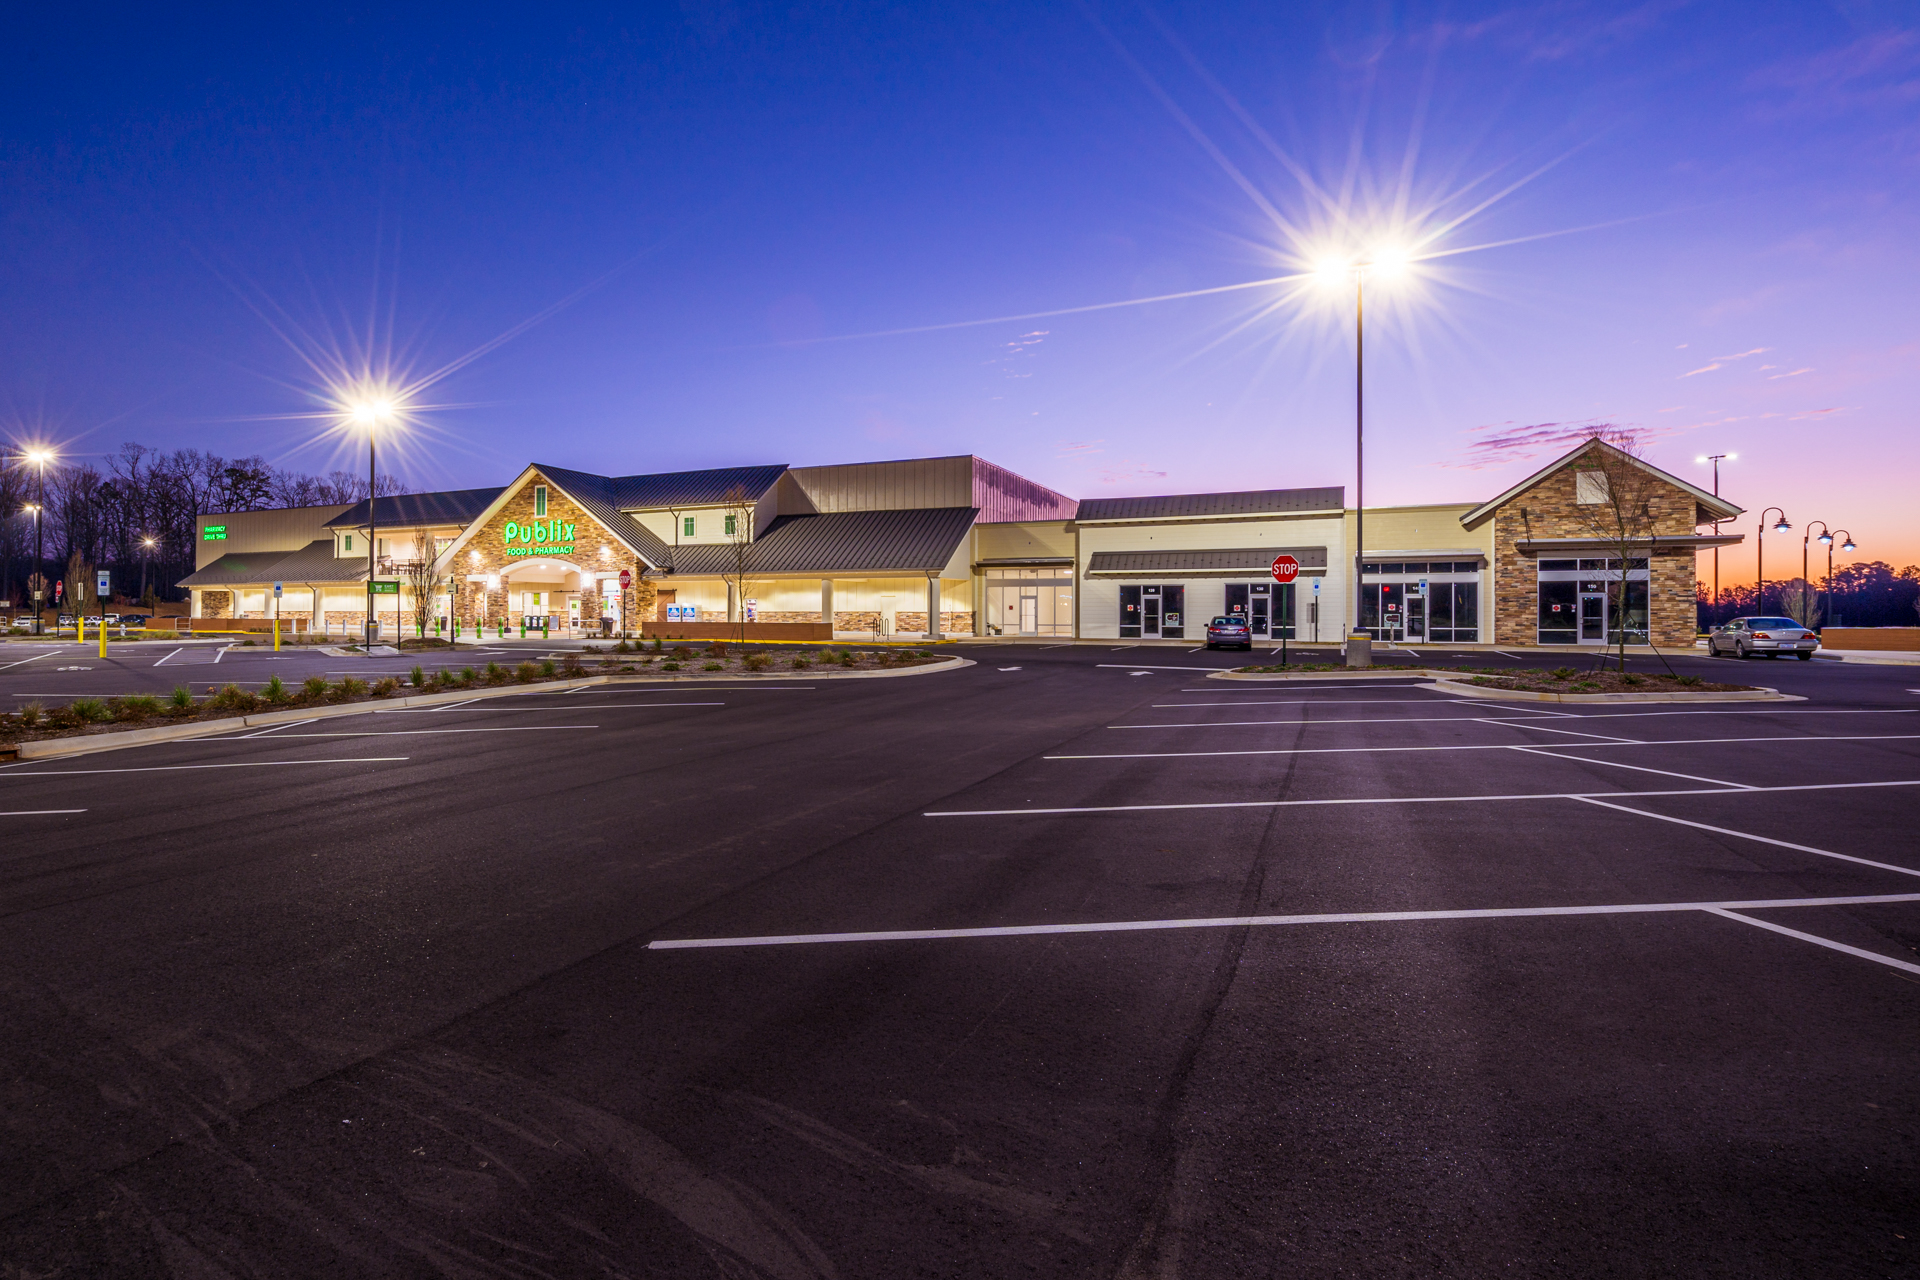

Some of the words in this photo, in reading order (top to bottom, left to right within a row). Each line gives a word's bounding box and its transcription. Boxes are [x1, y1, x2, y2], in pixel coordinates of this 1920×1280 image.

[204, 525, 226, 533] PHARMACY
[505, 519, 575, 544] Publix
[506, 547, 527, 556] FOOD
[528, 547, 534, 556] &
[535, 545, 575, 555] PHARMACY
[1273, 563, 1298, 575] STOP
[620, 575, 630, 584] STOP
